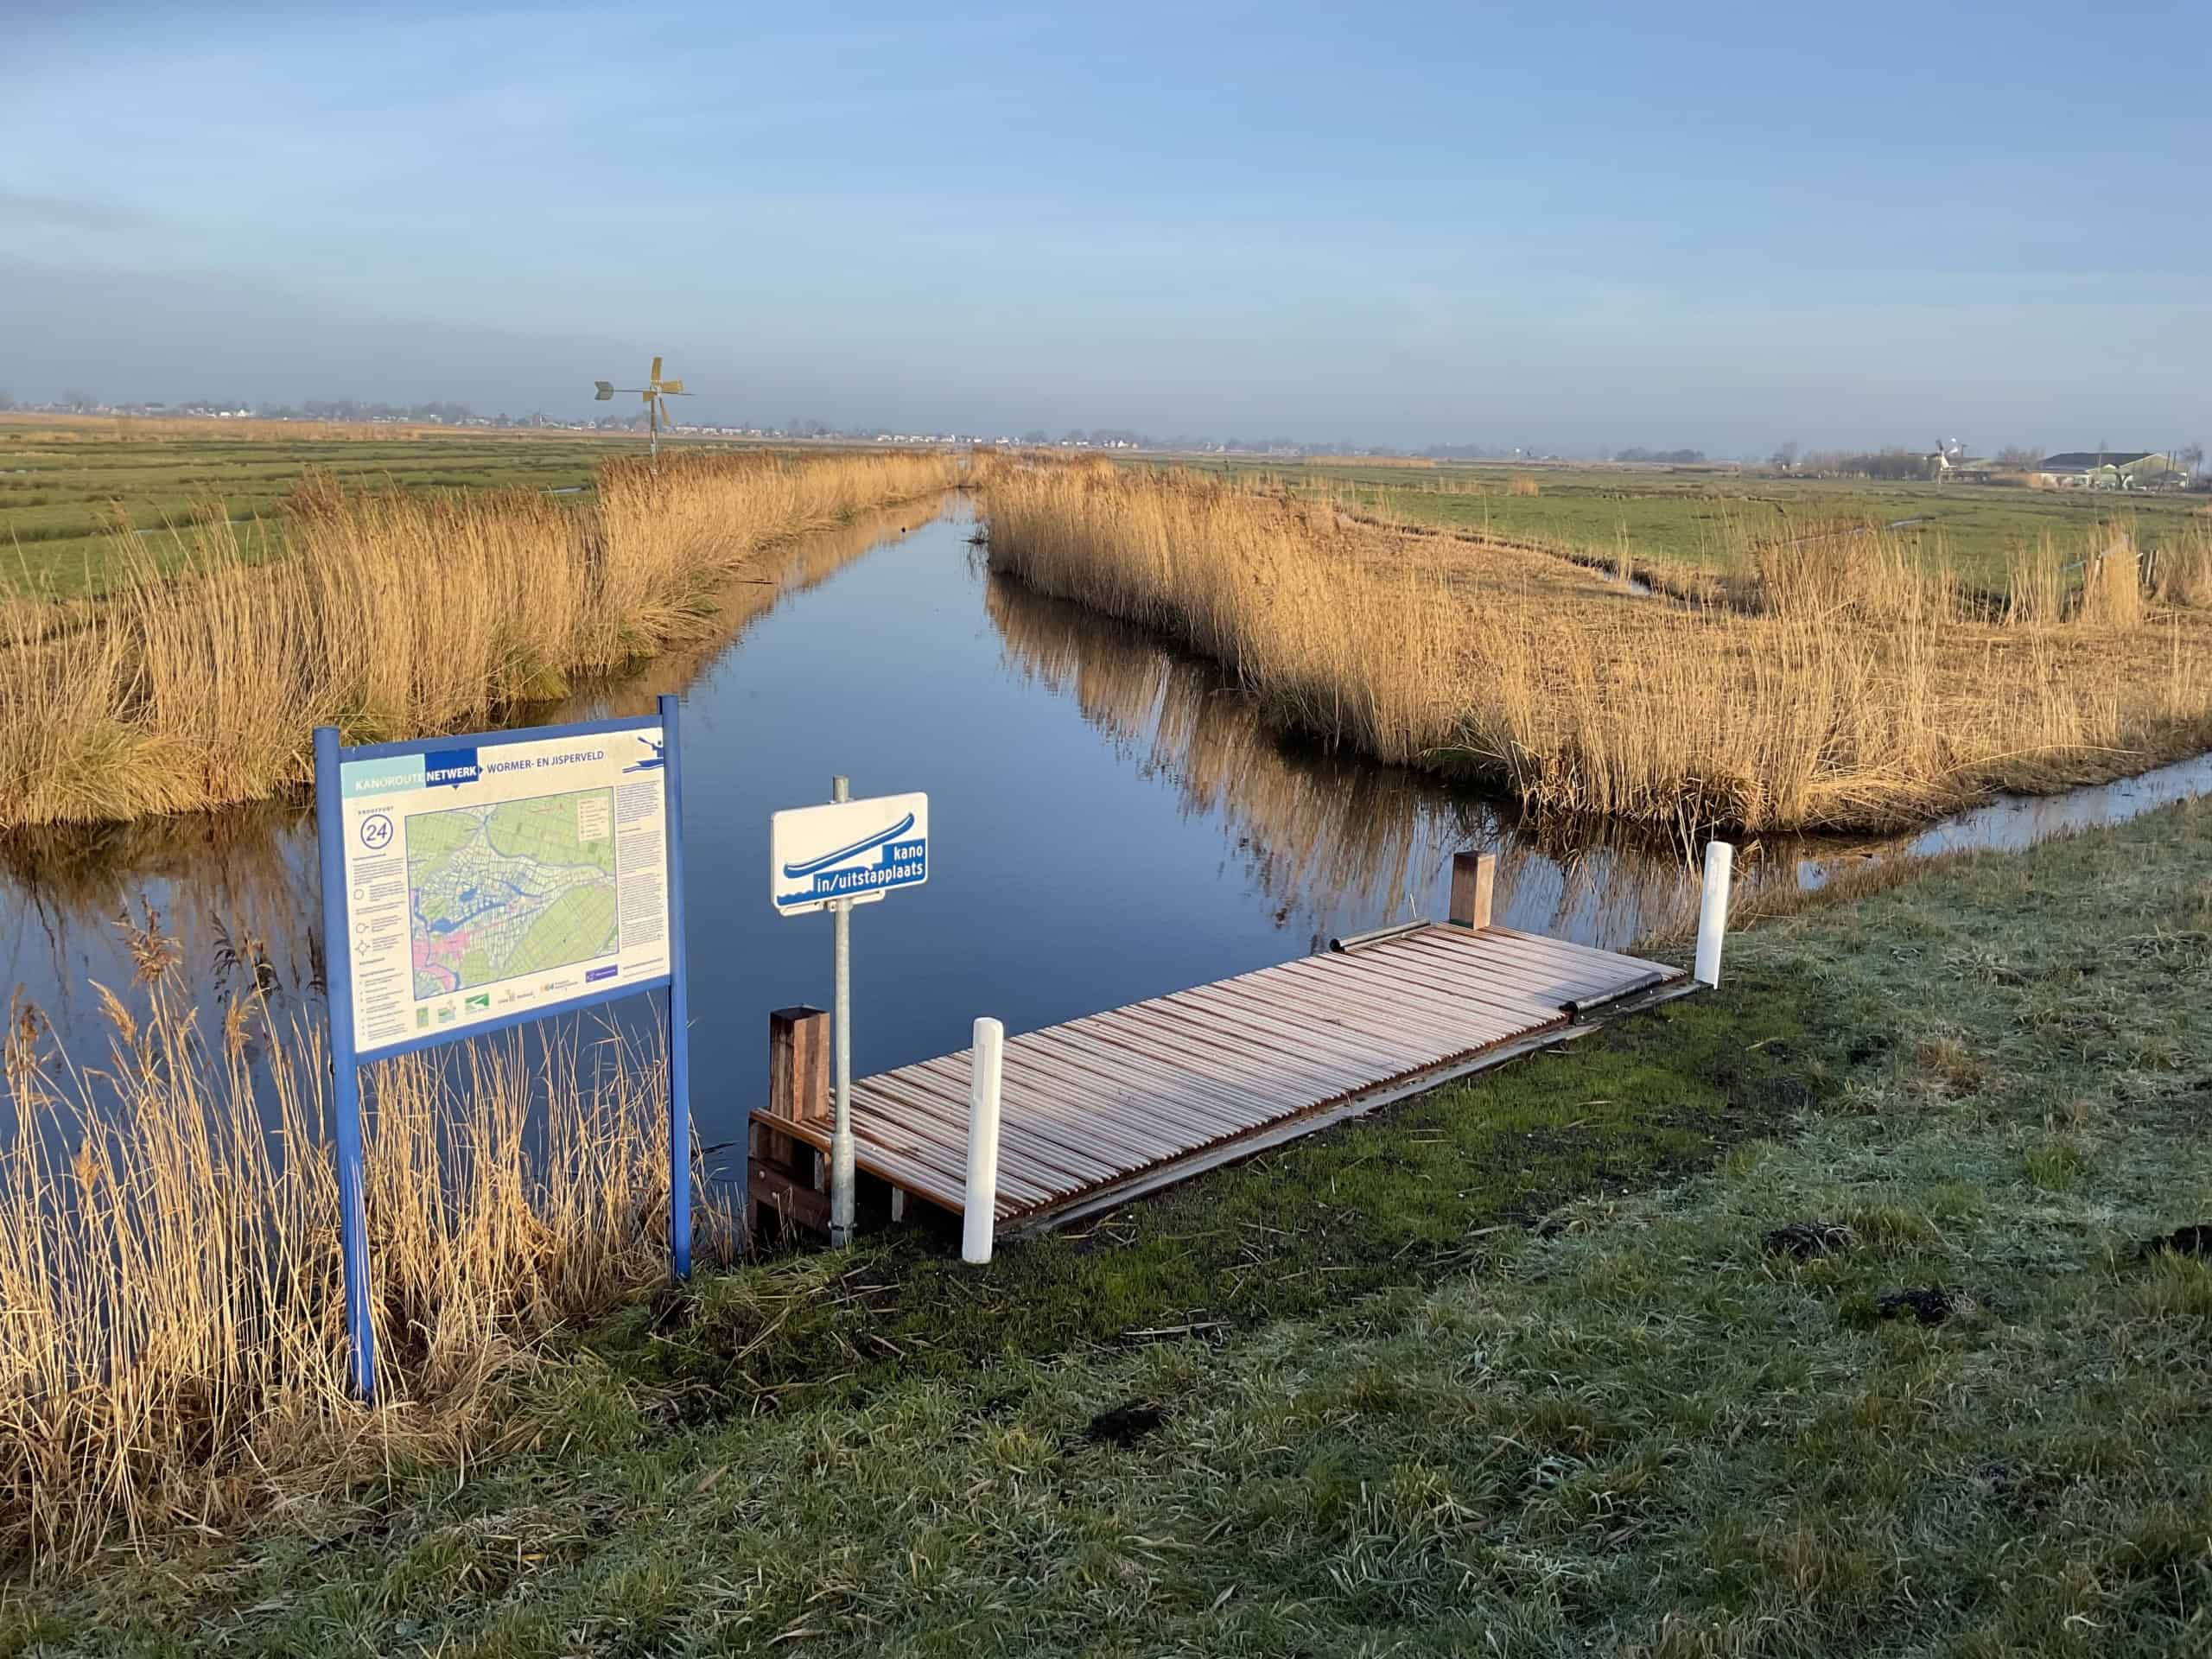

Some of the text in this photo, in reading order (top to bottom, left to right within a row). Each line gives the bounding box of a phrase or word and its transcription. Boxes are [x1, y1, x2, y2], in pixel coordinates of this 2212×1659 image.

[486, 750, 605, 773] WORMER- EN JISPERVELD
[426, 766, 478, 782] NETWERK
[365, 823, 388, 842] 24
[893, 844, 924, 861] kano
[817, 861, 924, 893] in/uitstapplaats
